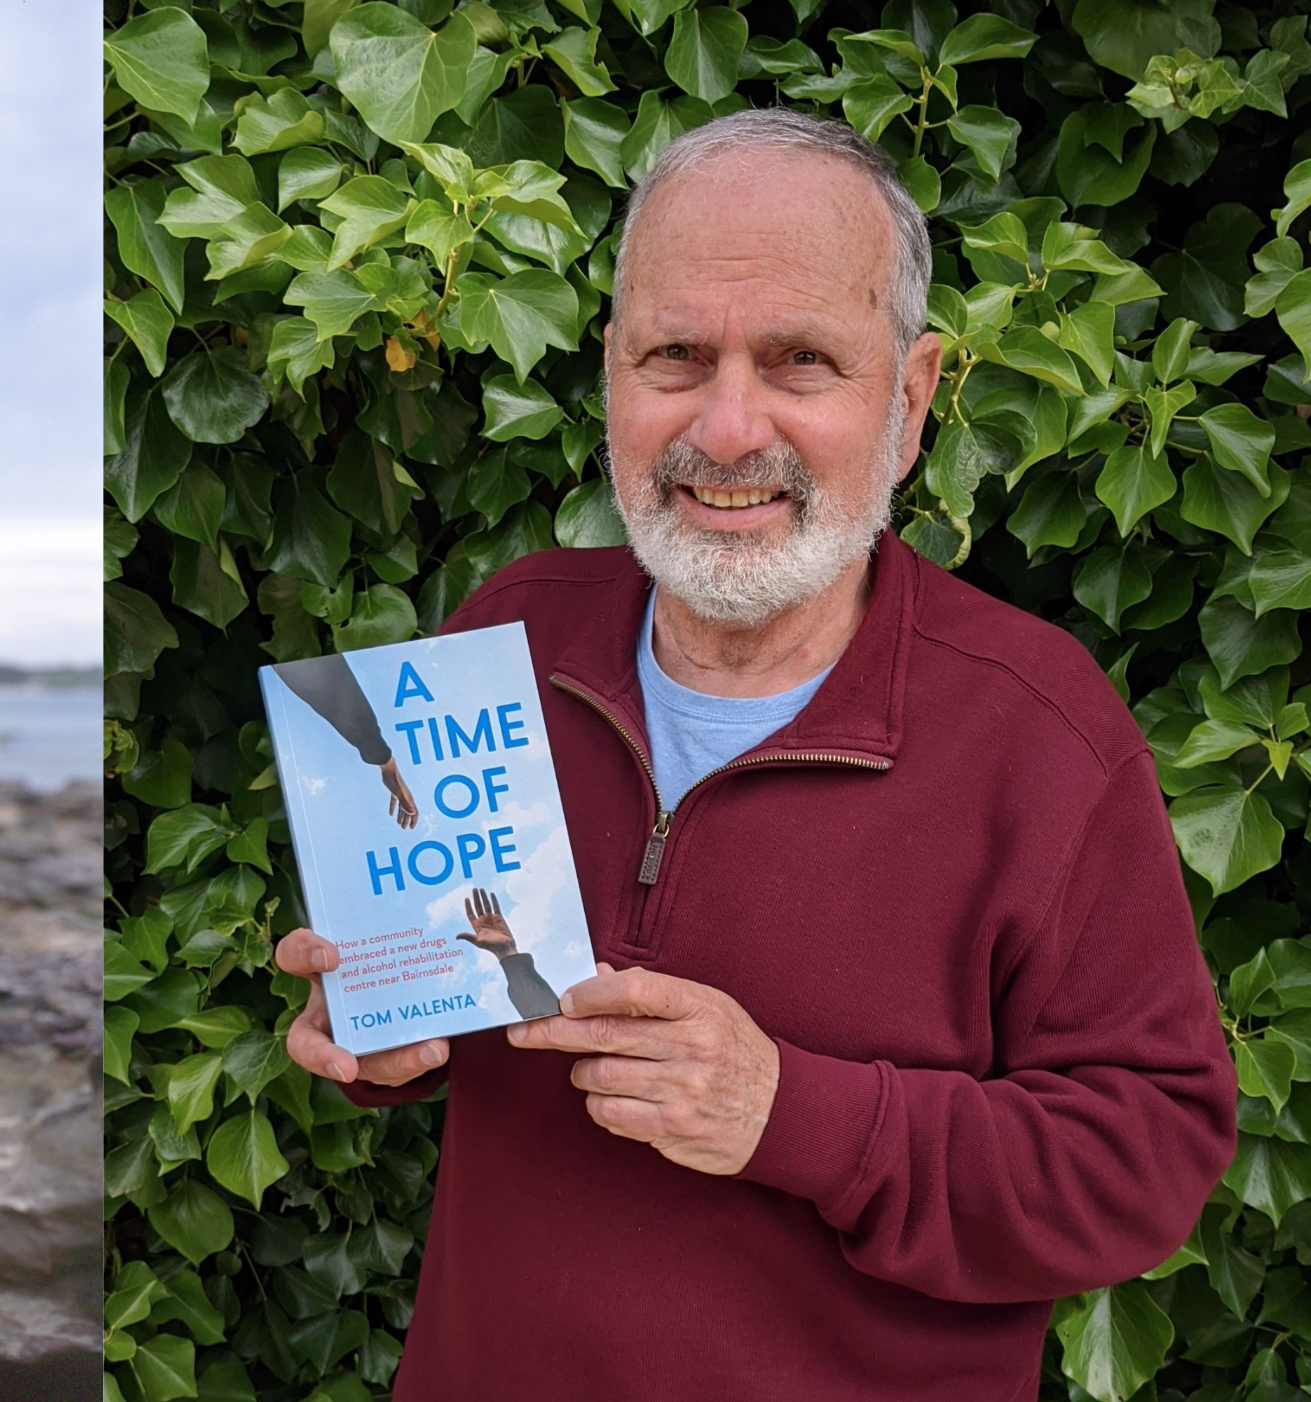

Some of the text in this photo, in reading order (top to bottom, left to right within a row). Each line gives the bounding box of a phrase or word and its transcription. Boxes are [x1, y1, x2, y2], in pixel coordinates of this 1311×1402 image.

[394, 661, 435, 707] A
[395, 702, 529, 765] TIME
[434, 766, 509, 818] OF
[366, 826, 521, 895] HOPE
[336, 927, 424, 950] How a community
[339, 937, 447, 965] embraced a new drugs
[341, 949, 464, 979] and alcohol rehabilitation
[344, 964, 454, 993] centre near Bairnsdale
[350, 993, 477, 1031] TOM VALENTA
